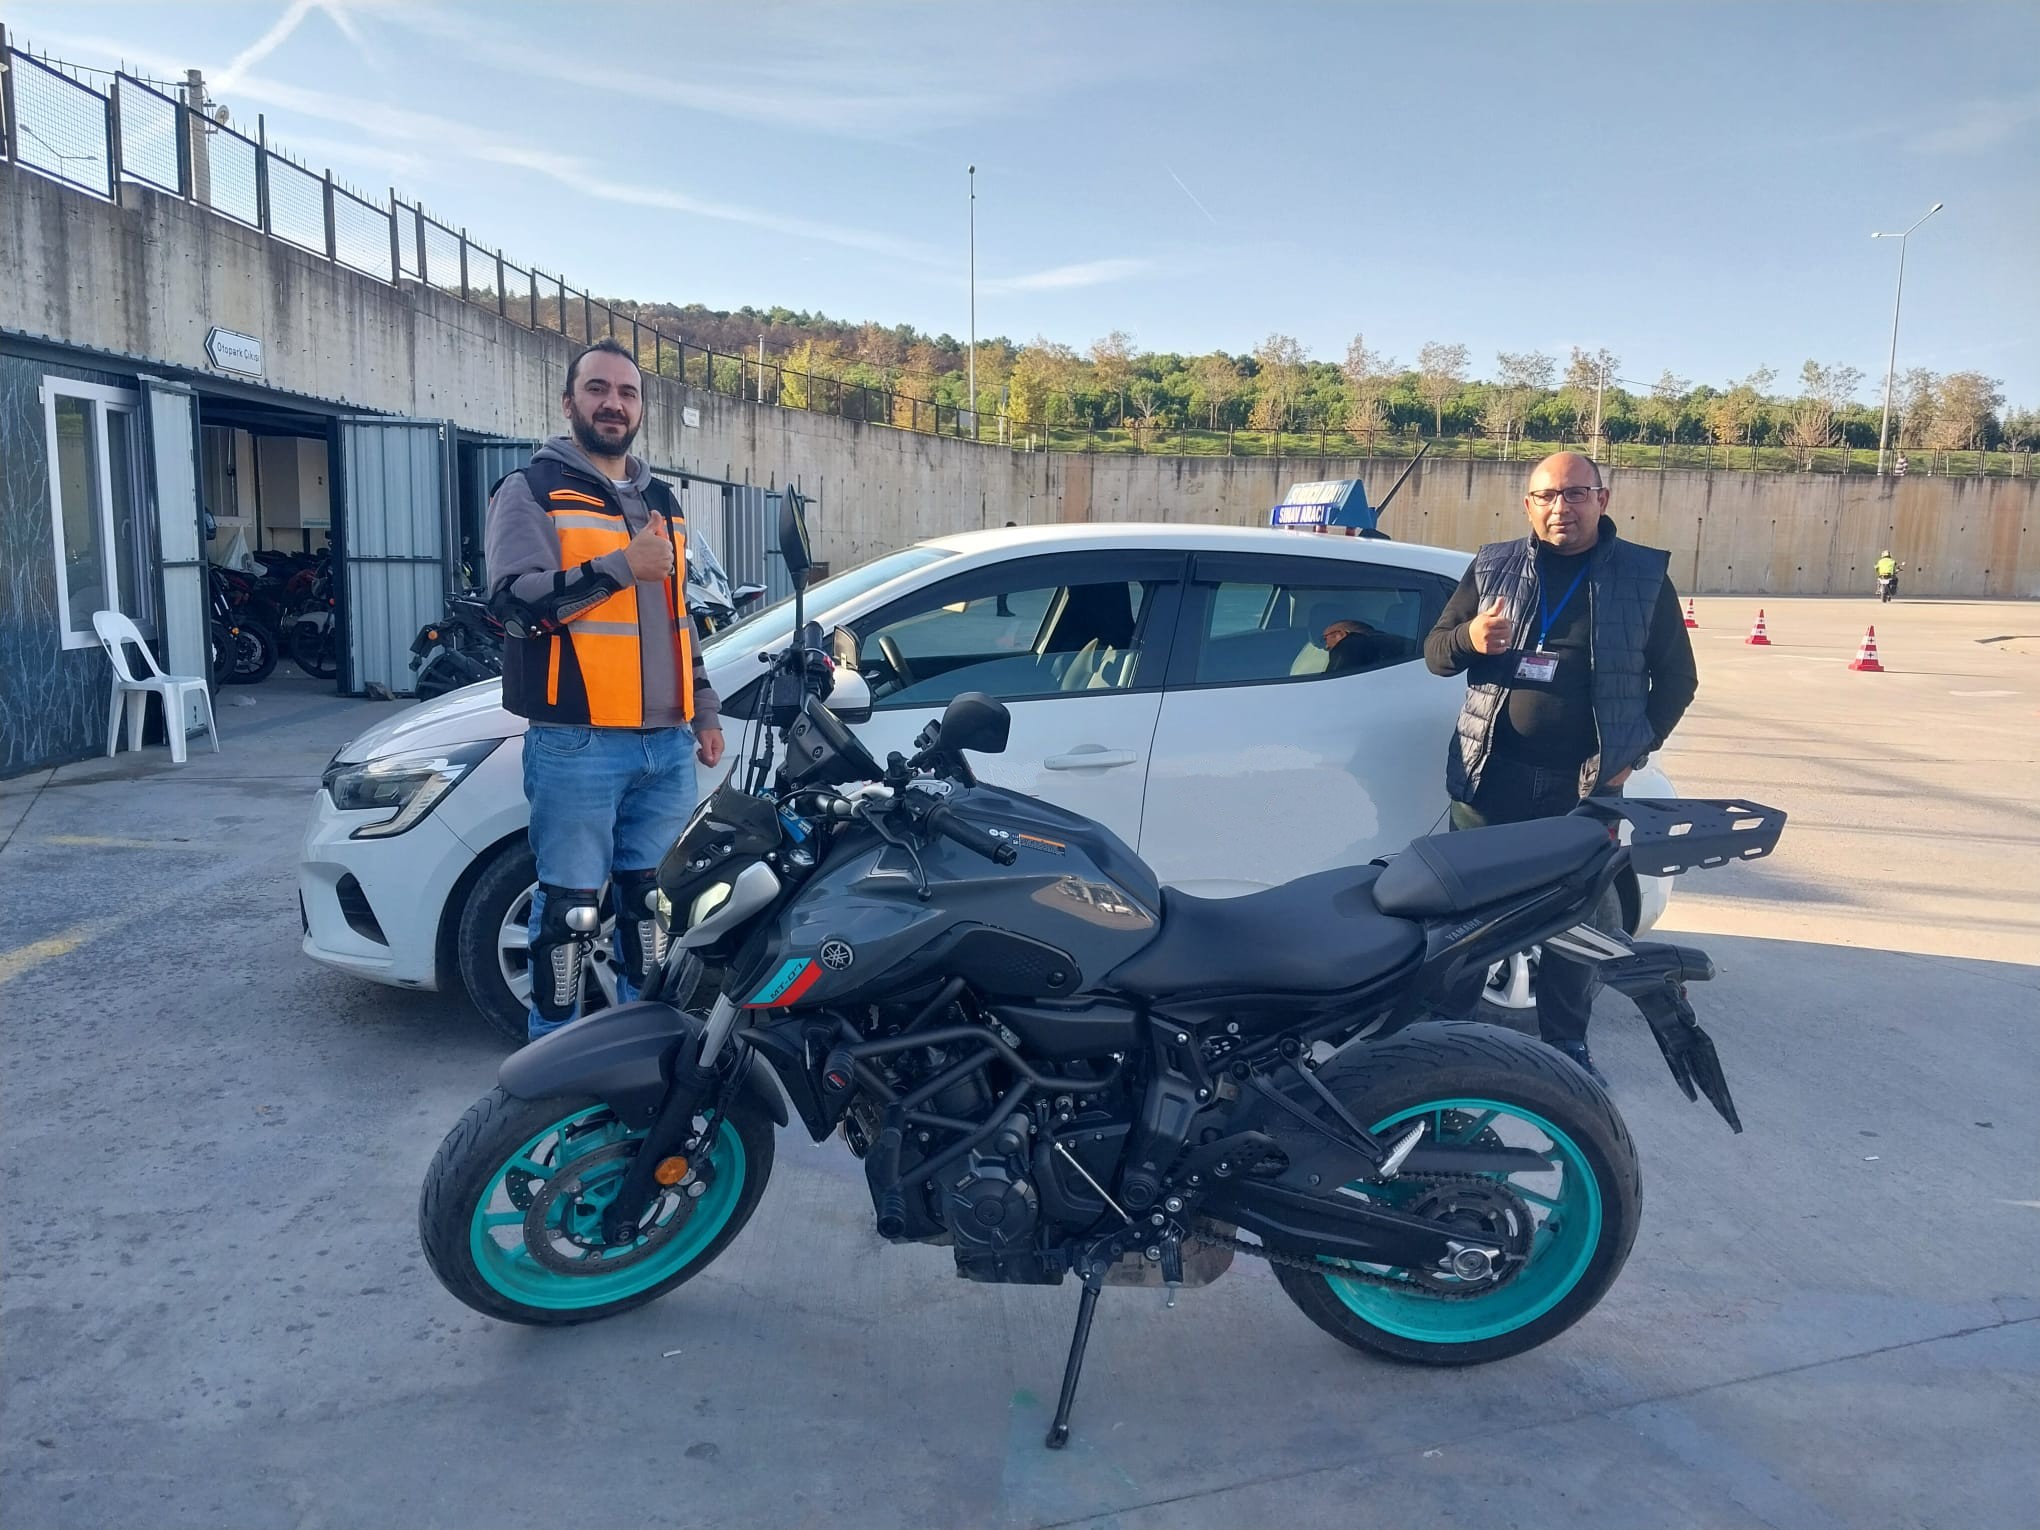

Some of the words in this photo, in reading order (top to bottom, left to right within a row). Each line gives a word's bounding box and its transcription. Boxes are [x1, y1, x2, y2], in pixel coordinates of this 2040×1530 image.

[217, 342, 243, 357] Otopark
[1445, 918, 1483, 941] YAMAHA
[769, 962, 803, 1000] MT-07
